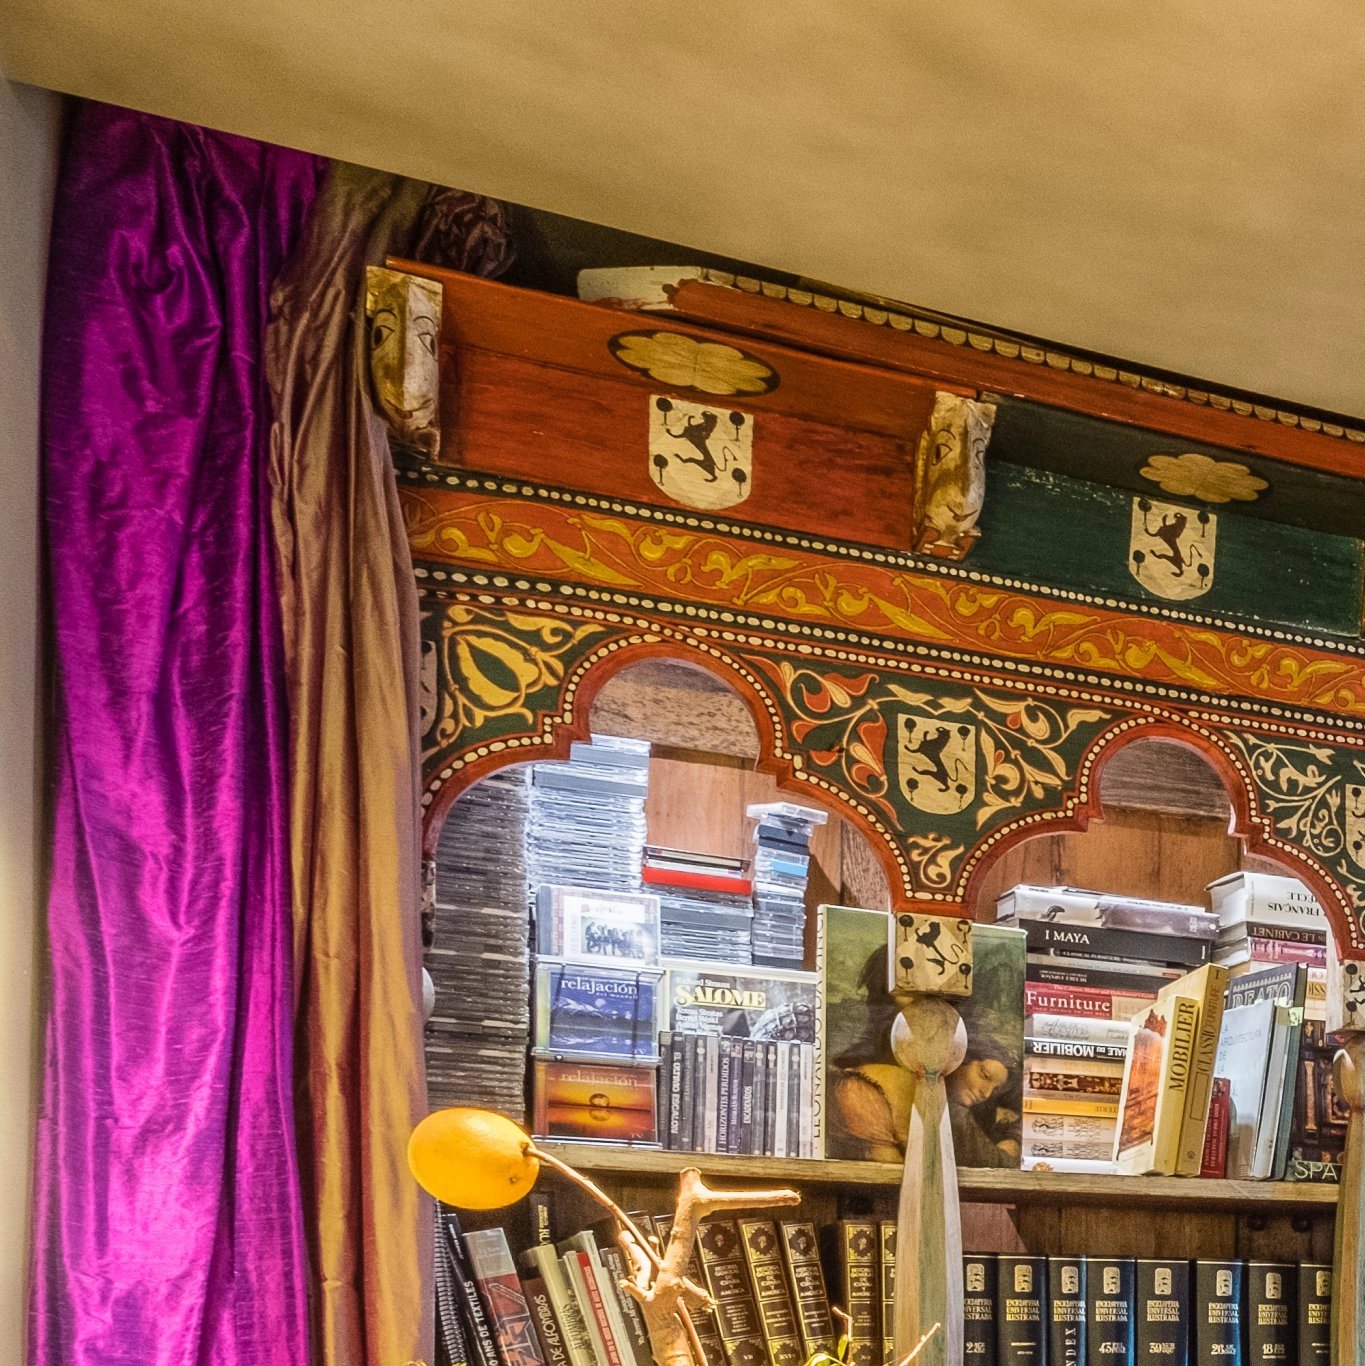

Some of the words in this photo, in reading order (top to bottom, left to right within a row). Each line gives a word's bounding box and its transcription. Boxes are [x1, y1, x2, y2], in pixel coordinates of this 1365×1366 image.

[1267, 902, 1320, 916] FRANÇAIS
[1045, 930, 1050, 940] I
[1053, 931, 1090, 945] MAYA
[1252, 926, 1300, 940] CABINET
[1302, 933, 1316, 942] LE
[561, 976, 638, 995] relajación
[674, 985, 766, 1008] SALOME
[1025, 990, 1110, 1012] Furniture
[1206, 985, 1220, 1027] FURNITURE
[1033, 1041, 1095, 1057] MOBILIER
[1168, 1002, 1195, 1092] MOBILIER
[1198, 1027, 1216, 1072] CLASSIC
[561, 1070, 638, 1087] relajación
[720, 1057, 730, 1095] PERDIDOS
[744, 1086, 753, 1124] ENCADENADOS
[719, 1096, 729, 1145] HORIZONTES
[463, 1280, 485, 1322] TEXTILES
[479, 1324, 490, 1336] DE
[534, 1295, 561, 1345] ALFOMBRAS
[483, 1339, 497, 1357] ANS
[550, 1346, 564, 1360] DE
